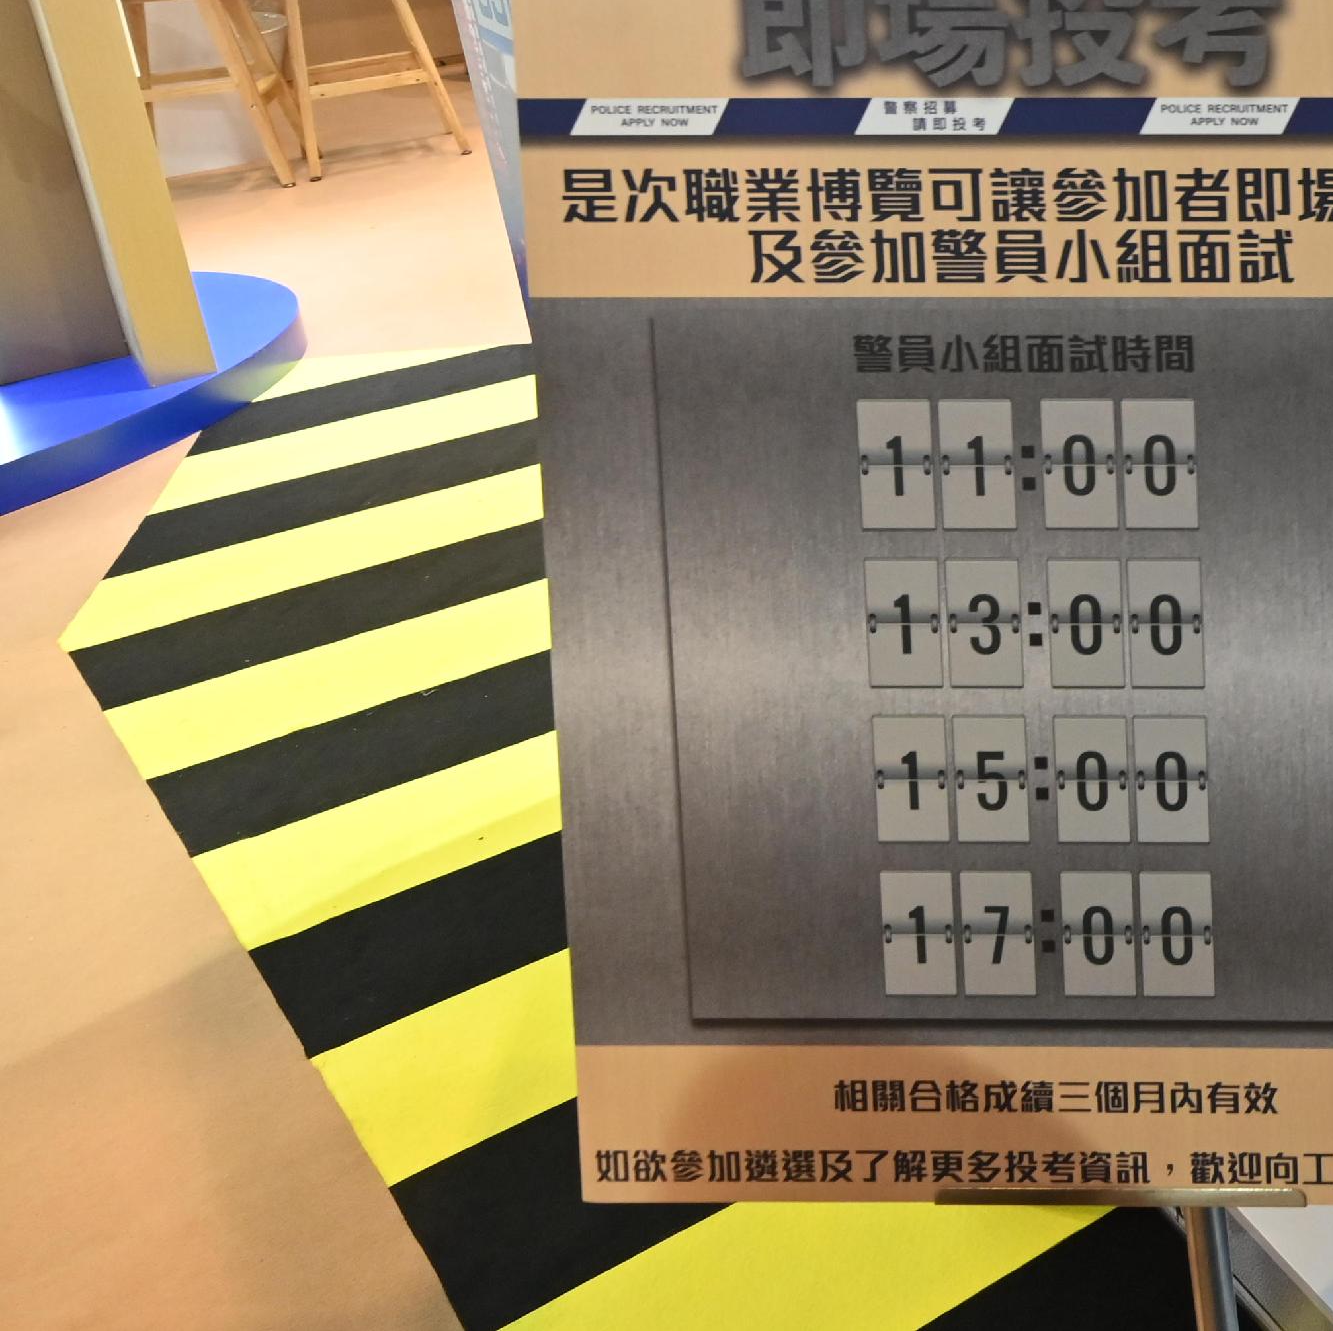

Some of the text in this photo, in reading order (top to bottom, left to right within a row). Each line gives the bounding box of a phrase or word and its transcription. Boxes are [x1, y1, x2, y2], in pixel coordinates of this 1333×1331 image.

[590, 104, 718, 115] POLICE RECRUITMENT
[883, 100, 957, 115] 警察招募
[1160, 103, 1289, 114] POLICE RECRUITMENT
[1190, 116, 1259, 126] APPLY NOW
[620, 117, 689, 128] APPLY NOW
[912, 117, 986, 132] 請即投考
[747, 228, 1295, 284] 及參加警員小組面試
[852, 333, 1195, 373] 警員小組面試時間
[886, 434, 1176, 497] 11:00
[893, 593, 1183, 656] 13:00
[901, 750, 1189, 812] 15:00
[908, 905, 1194, 966] 17:00
